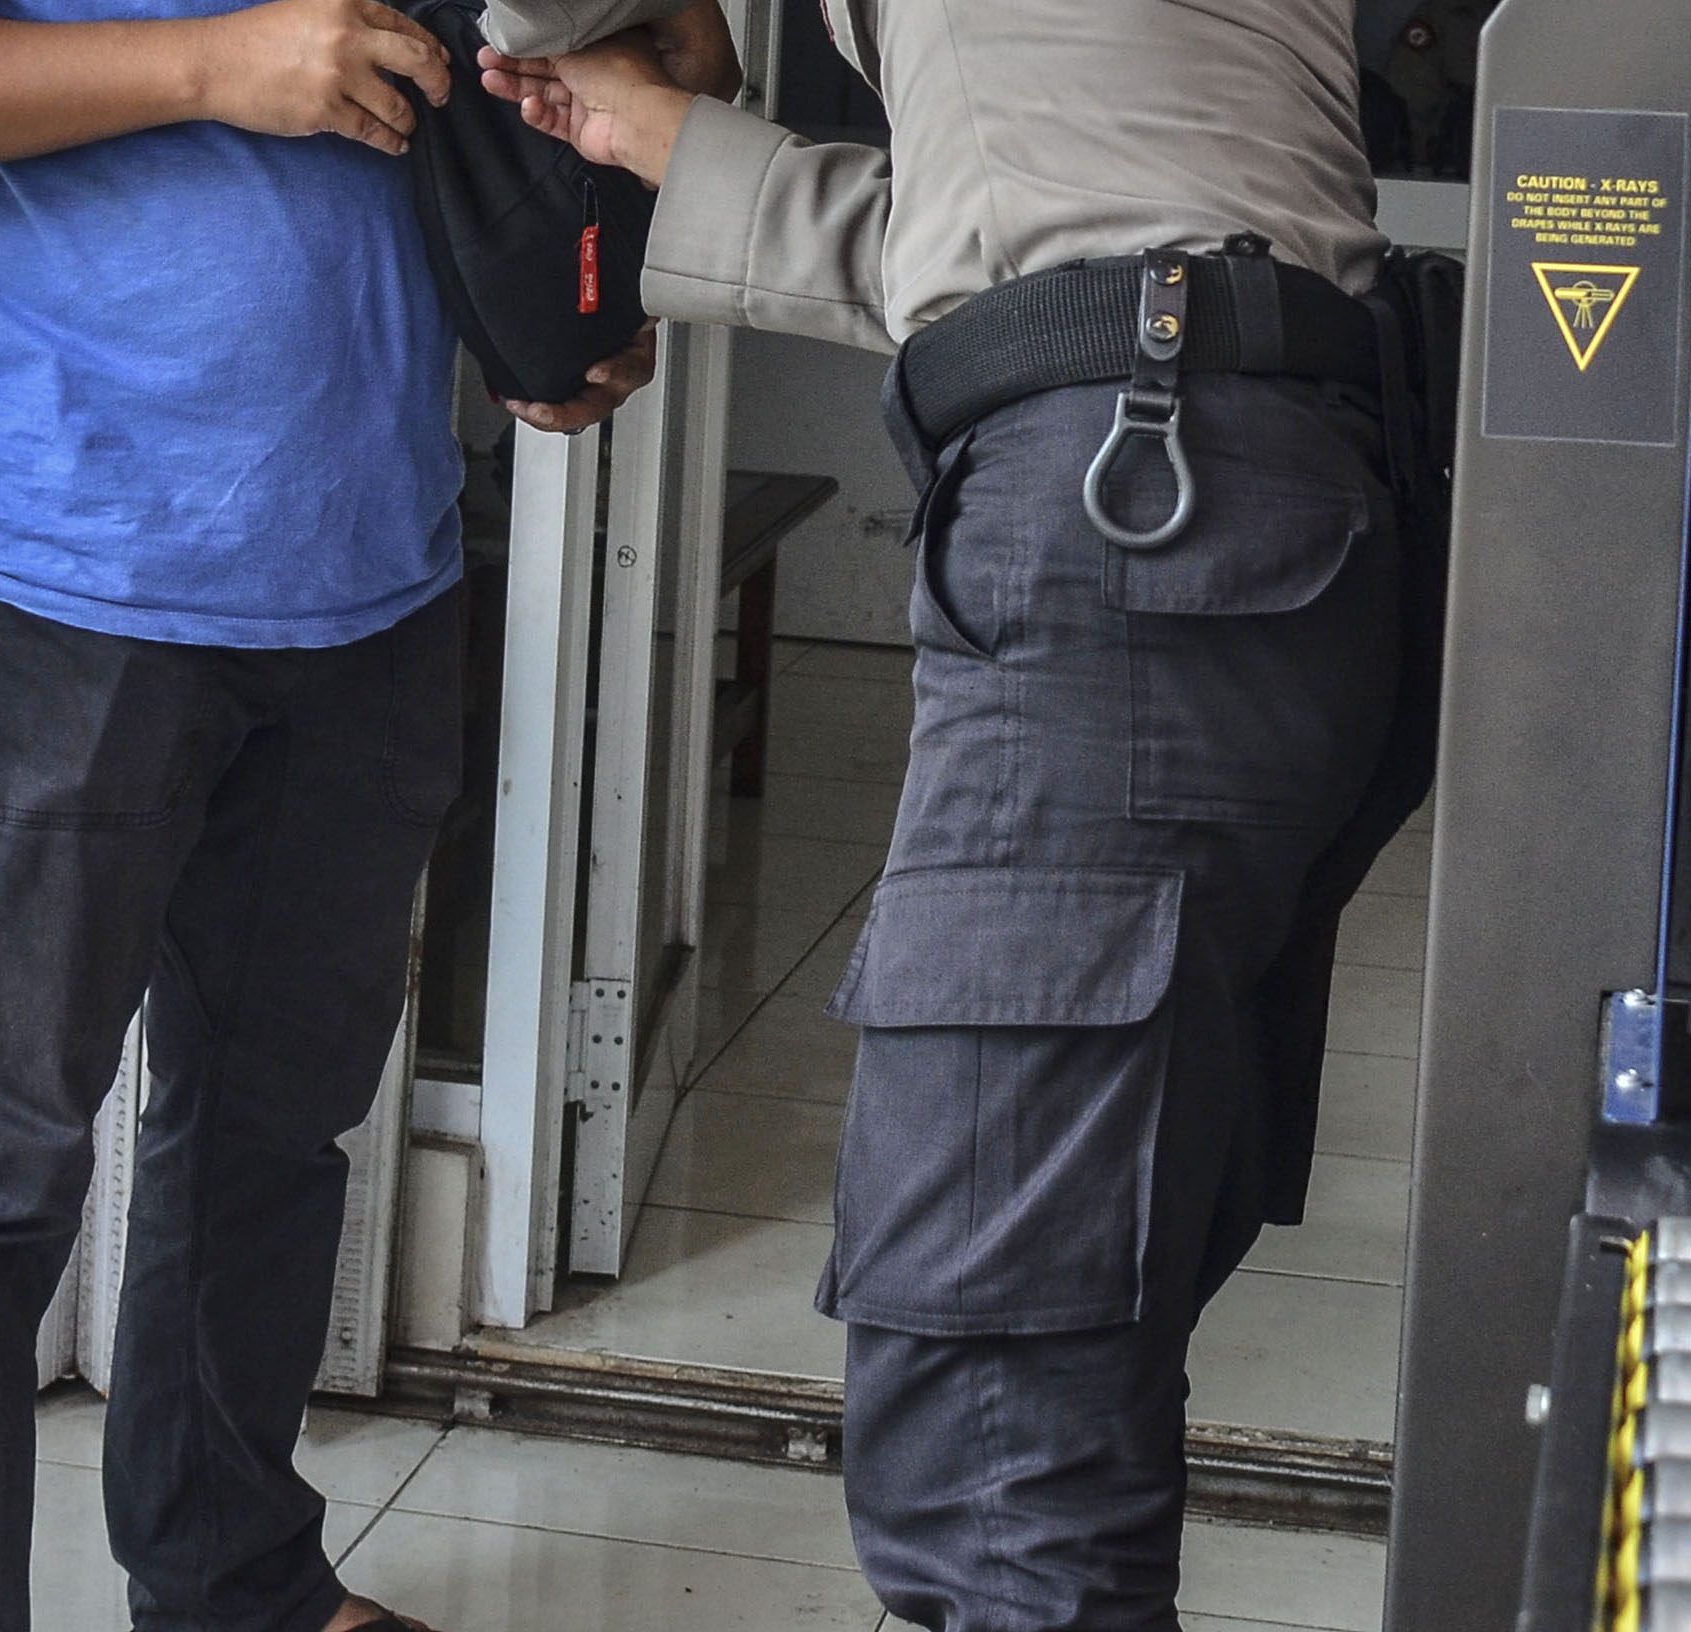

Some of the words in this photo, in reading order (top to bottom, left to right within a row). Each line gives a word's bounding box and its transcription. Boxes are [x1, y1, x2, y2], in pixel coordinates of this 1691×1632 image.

[1516, 174, 1587, 191] CAUTION
[1600, 178, 1659, 194] X-RAYS
[1507, 192, 1523, 202] DO
[1526, 192, 1549, 203] NOT
[1552, 194, 1591, 205] INSERT
[1593, 195, 1618, 206] ANY
[1620, 196, 1650, 208] PART
[1524, 205, 1545, 216] THE
[1547, 206, 1578, 217] BODY
[1580, 208, 1626, 220] BEYOND
[1629, 210, 1650, 221] THE
[1557, 220, 1591, 232] WHILE
[1638, 223, 1662, 235] ARE
[1535, 232, 1568, 244] BEING
[1570, 233, 1637, 247] GENERATED
